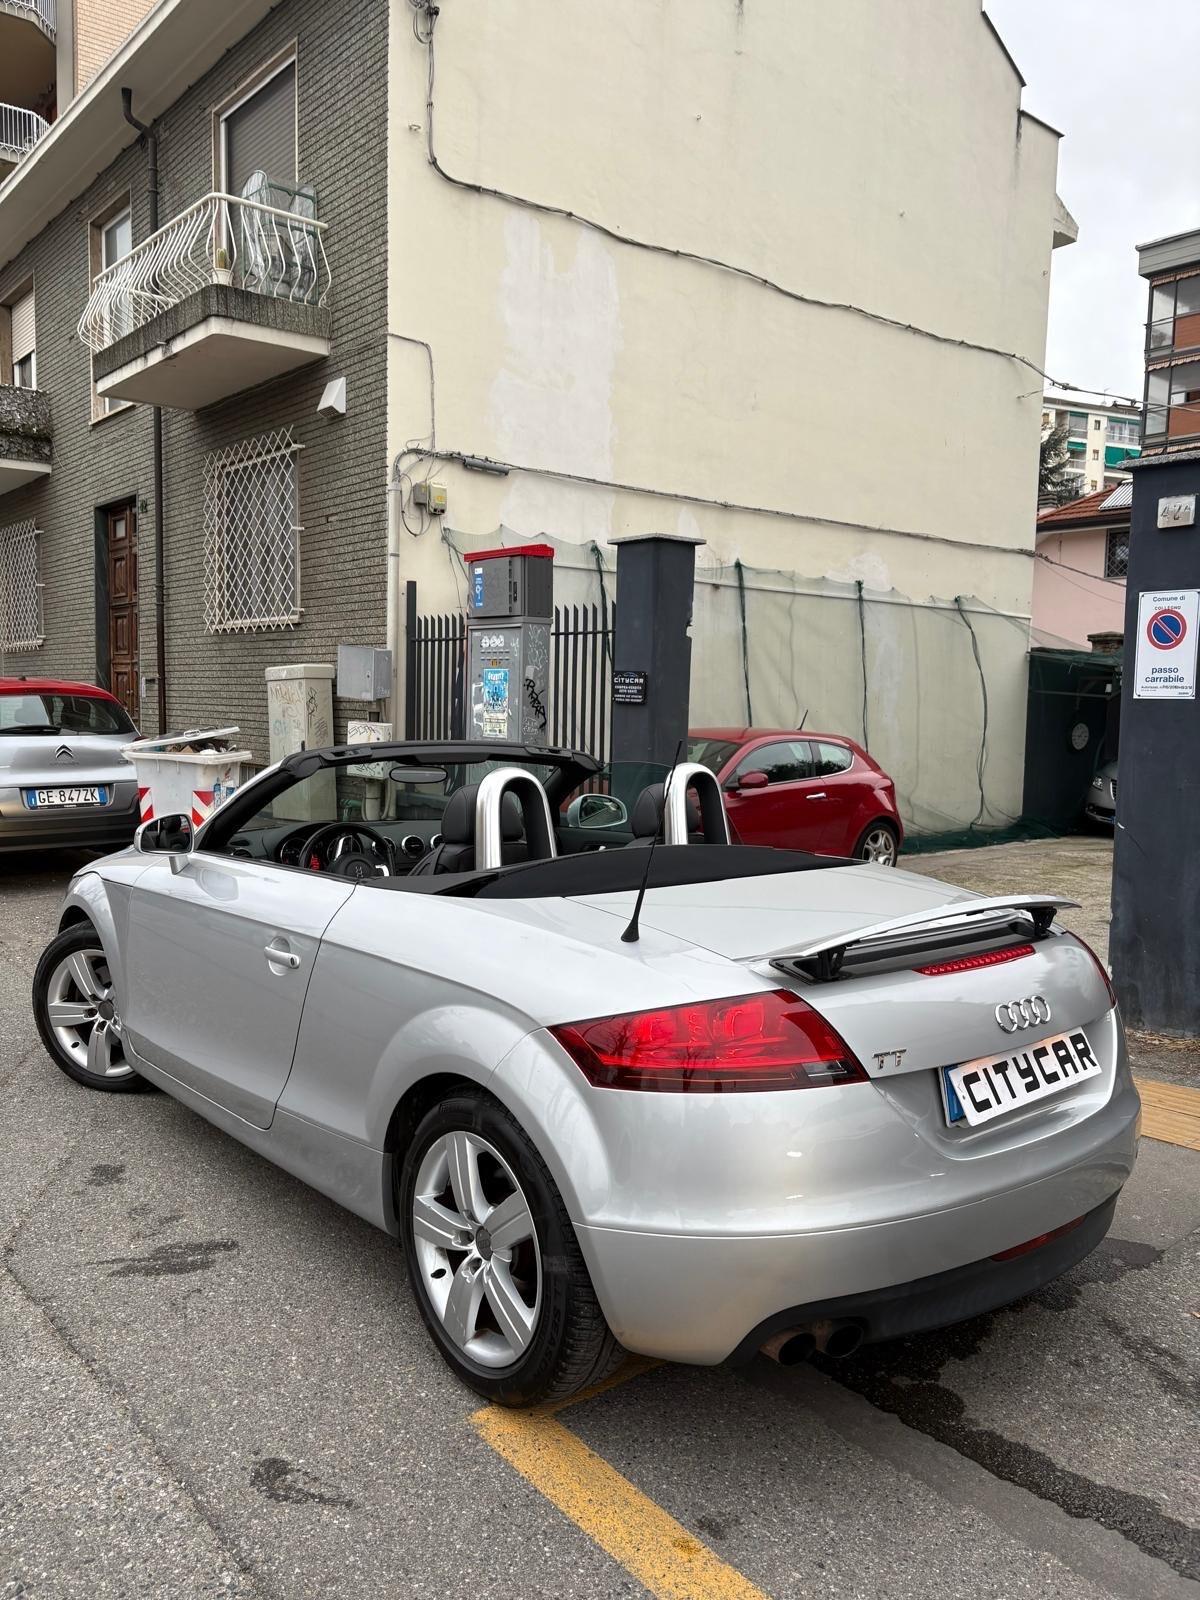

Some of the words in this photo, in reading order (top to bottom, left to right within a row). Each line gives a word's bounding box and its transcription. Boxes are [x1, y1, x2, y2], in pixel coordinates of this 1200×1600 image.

[1145, 675, 1185, 683] carrabile
[1152, 667, 1179, 675] passo
[38, 790, 55, 804] GE
[58, 788, 98, 803] 847ZK
[872, 1048, 907, 1070] TT
[963, 1032, 1097, 1113] CITYCAR
